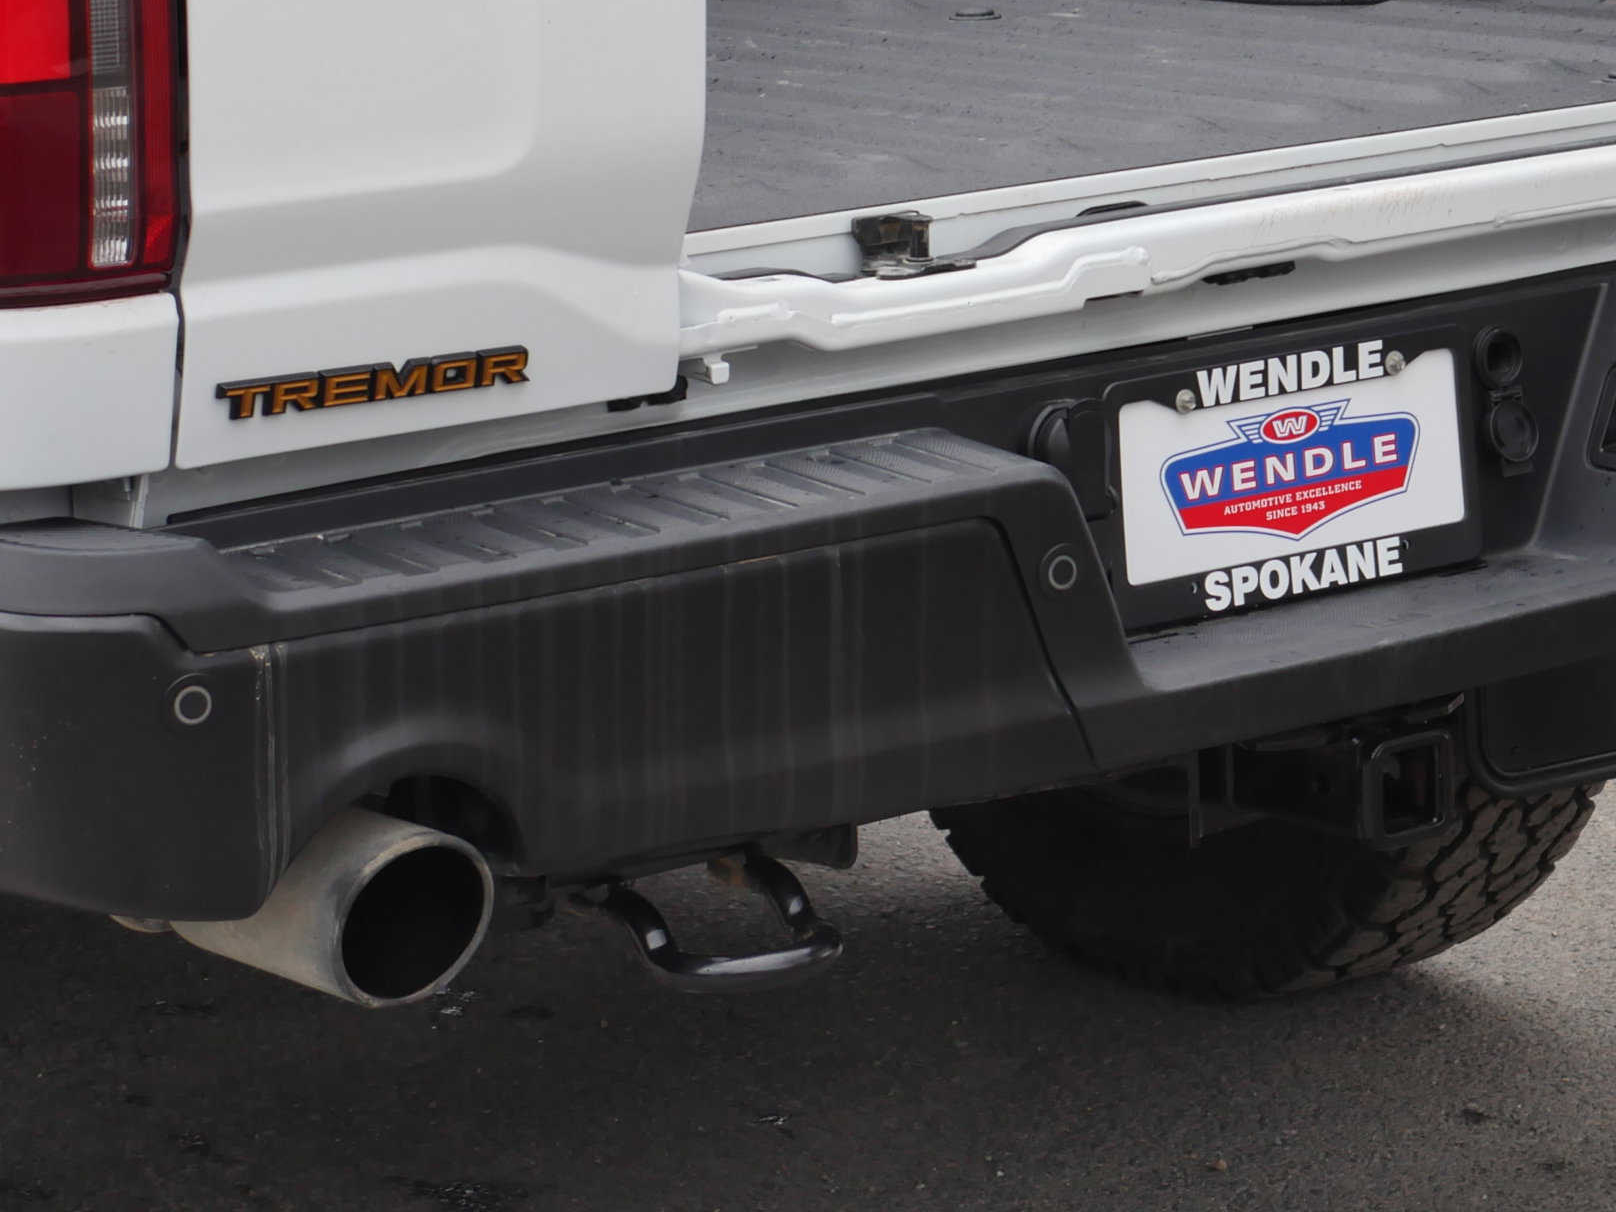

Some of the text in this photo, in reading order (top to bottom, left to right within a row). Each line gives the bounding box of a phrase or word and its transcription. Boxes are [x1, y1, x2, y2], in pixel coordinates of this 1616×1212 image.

[215, 344, 530, 420] TREMOR
[1196, 339, 1385, 407] WENDLE
[1179, 433, 1398, 501] WENDLE
[1223, 480, 1363, 516] AUTOMOTIVE EXCELLENCE
[1265, 500, 1326, 521] SINCE 1943
[1204, 535, 1404, 613] SPOKANE
